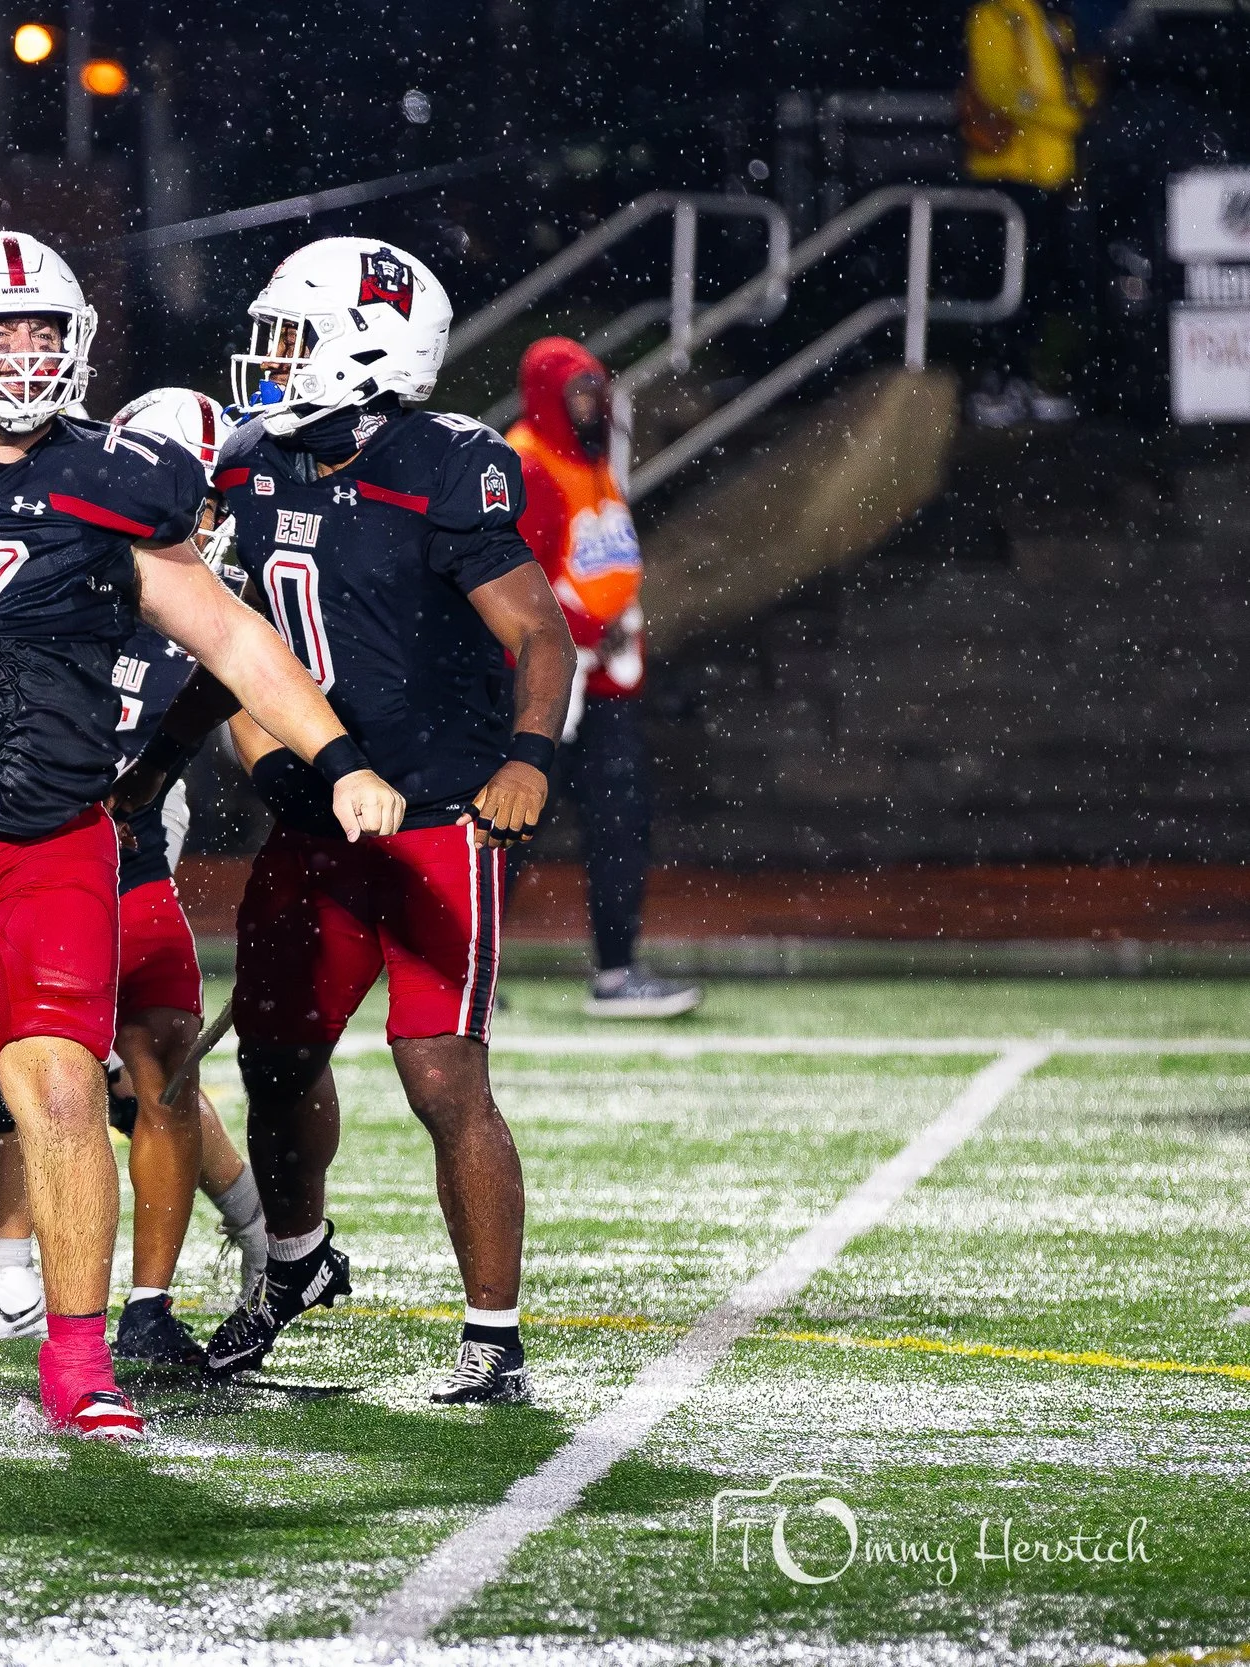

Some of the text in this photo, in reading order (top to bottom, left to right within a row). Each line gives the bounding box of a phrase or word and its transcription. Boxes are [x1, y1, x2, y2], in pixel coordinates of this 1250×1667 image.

[275, 509, 322, 547] ESU
[263, 550, 336, 695] 0
[111, 655, 150, 693] SU
[301, 1260, 333, 1307] NIKE
